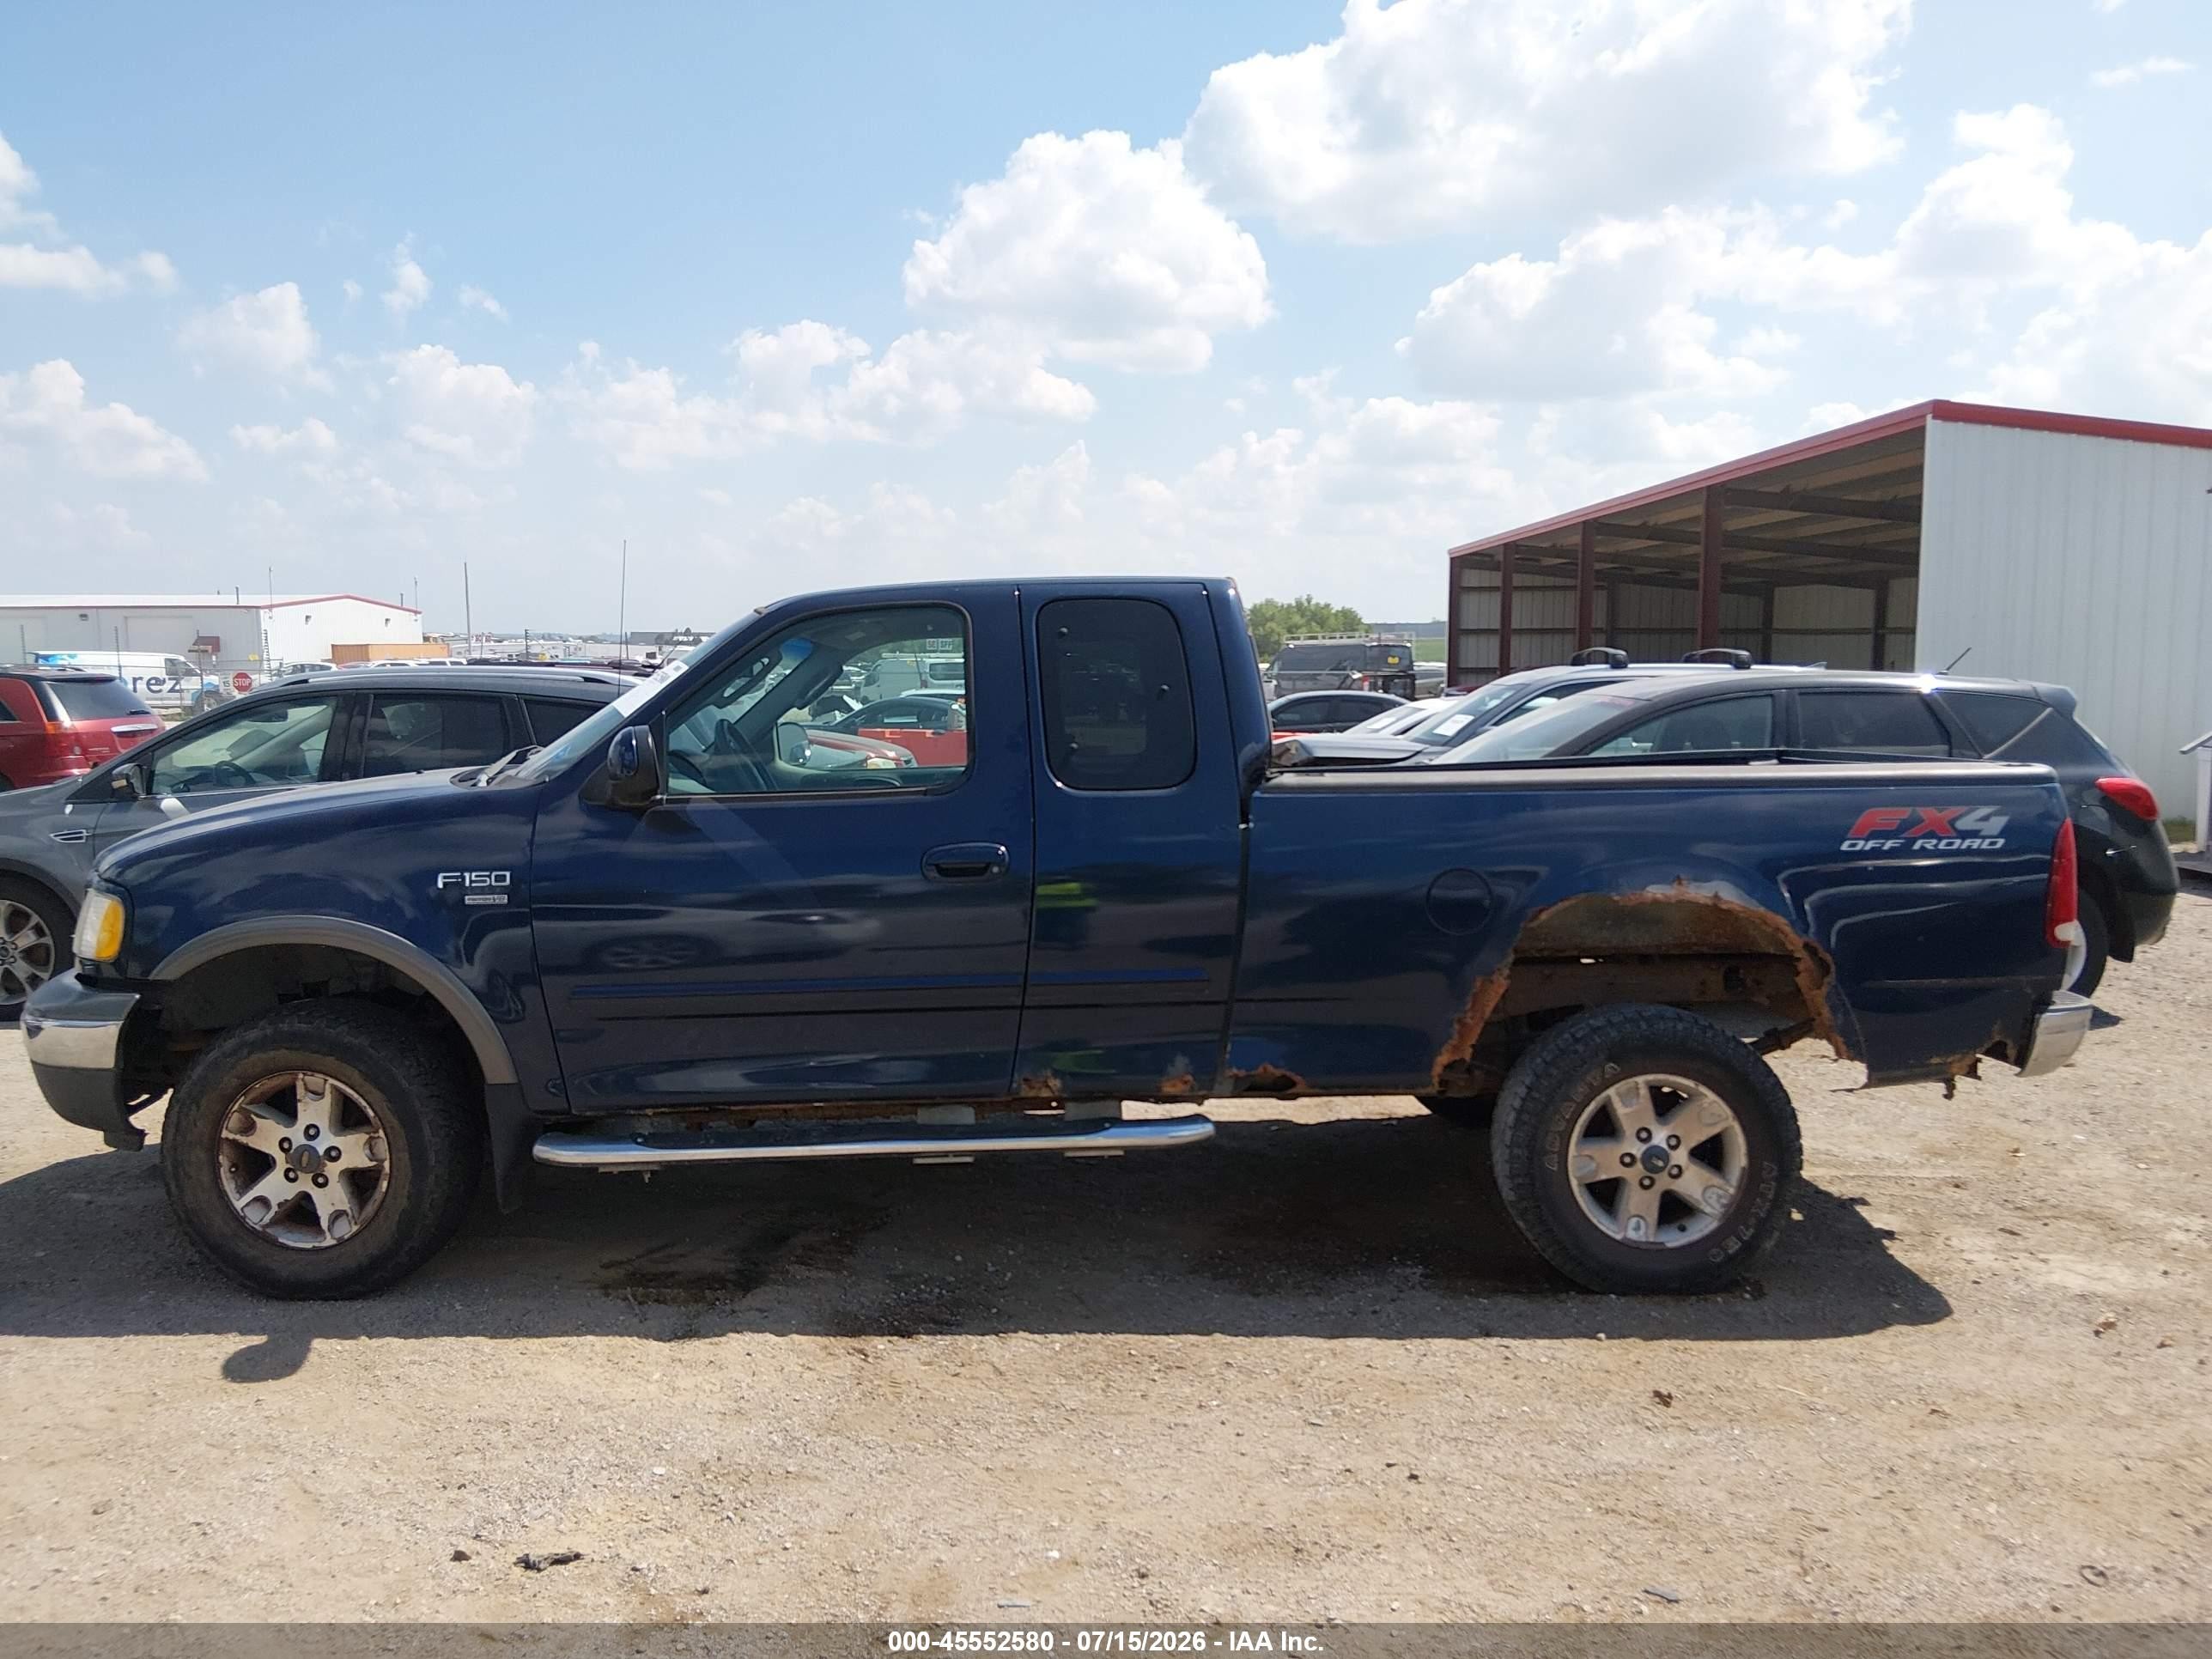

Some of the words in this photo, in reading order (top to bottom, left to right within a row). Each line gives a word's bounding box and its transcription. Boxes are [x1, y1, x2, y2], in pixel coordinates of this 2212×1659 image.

[234, 678, 252, 687] STOP
[1847, 805, 2010, 838] FX4
[1840, 839, 1904, 851] OFF
[1911, 838, 2006, 850] ROAD
